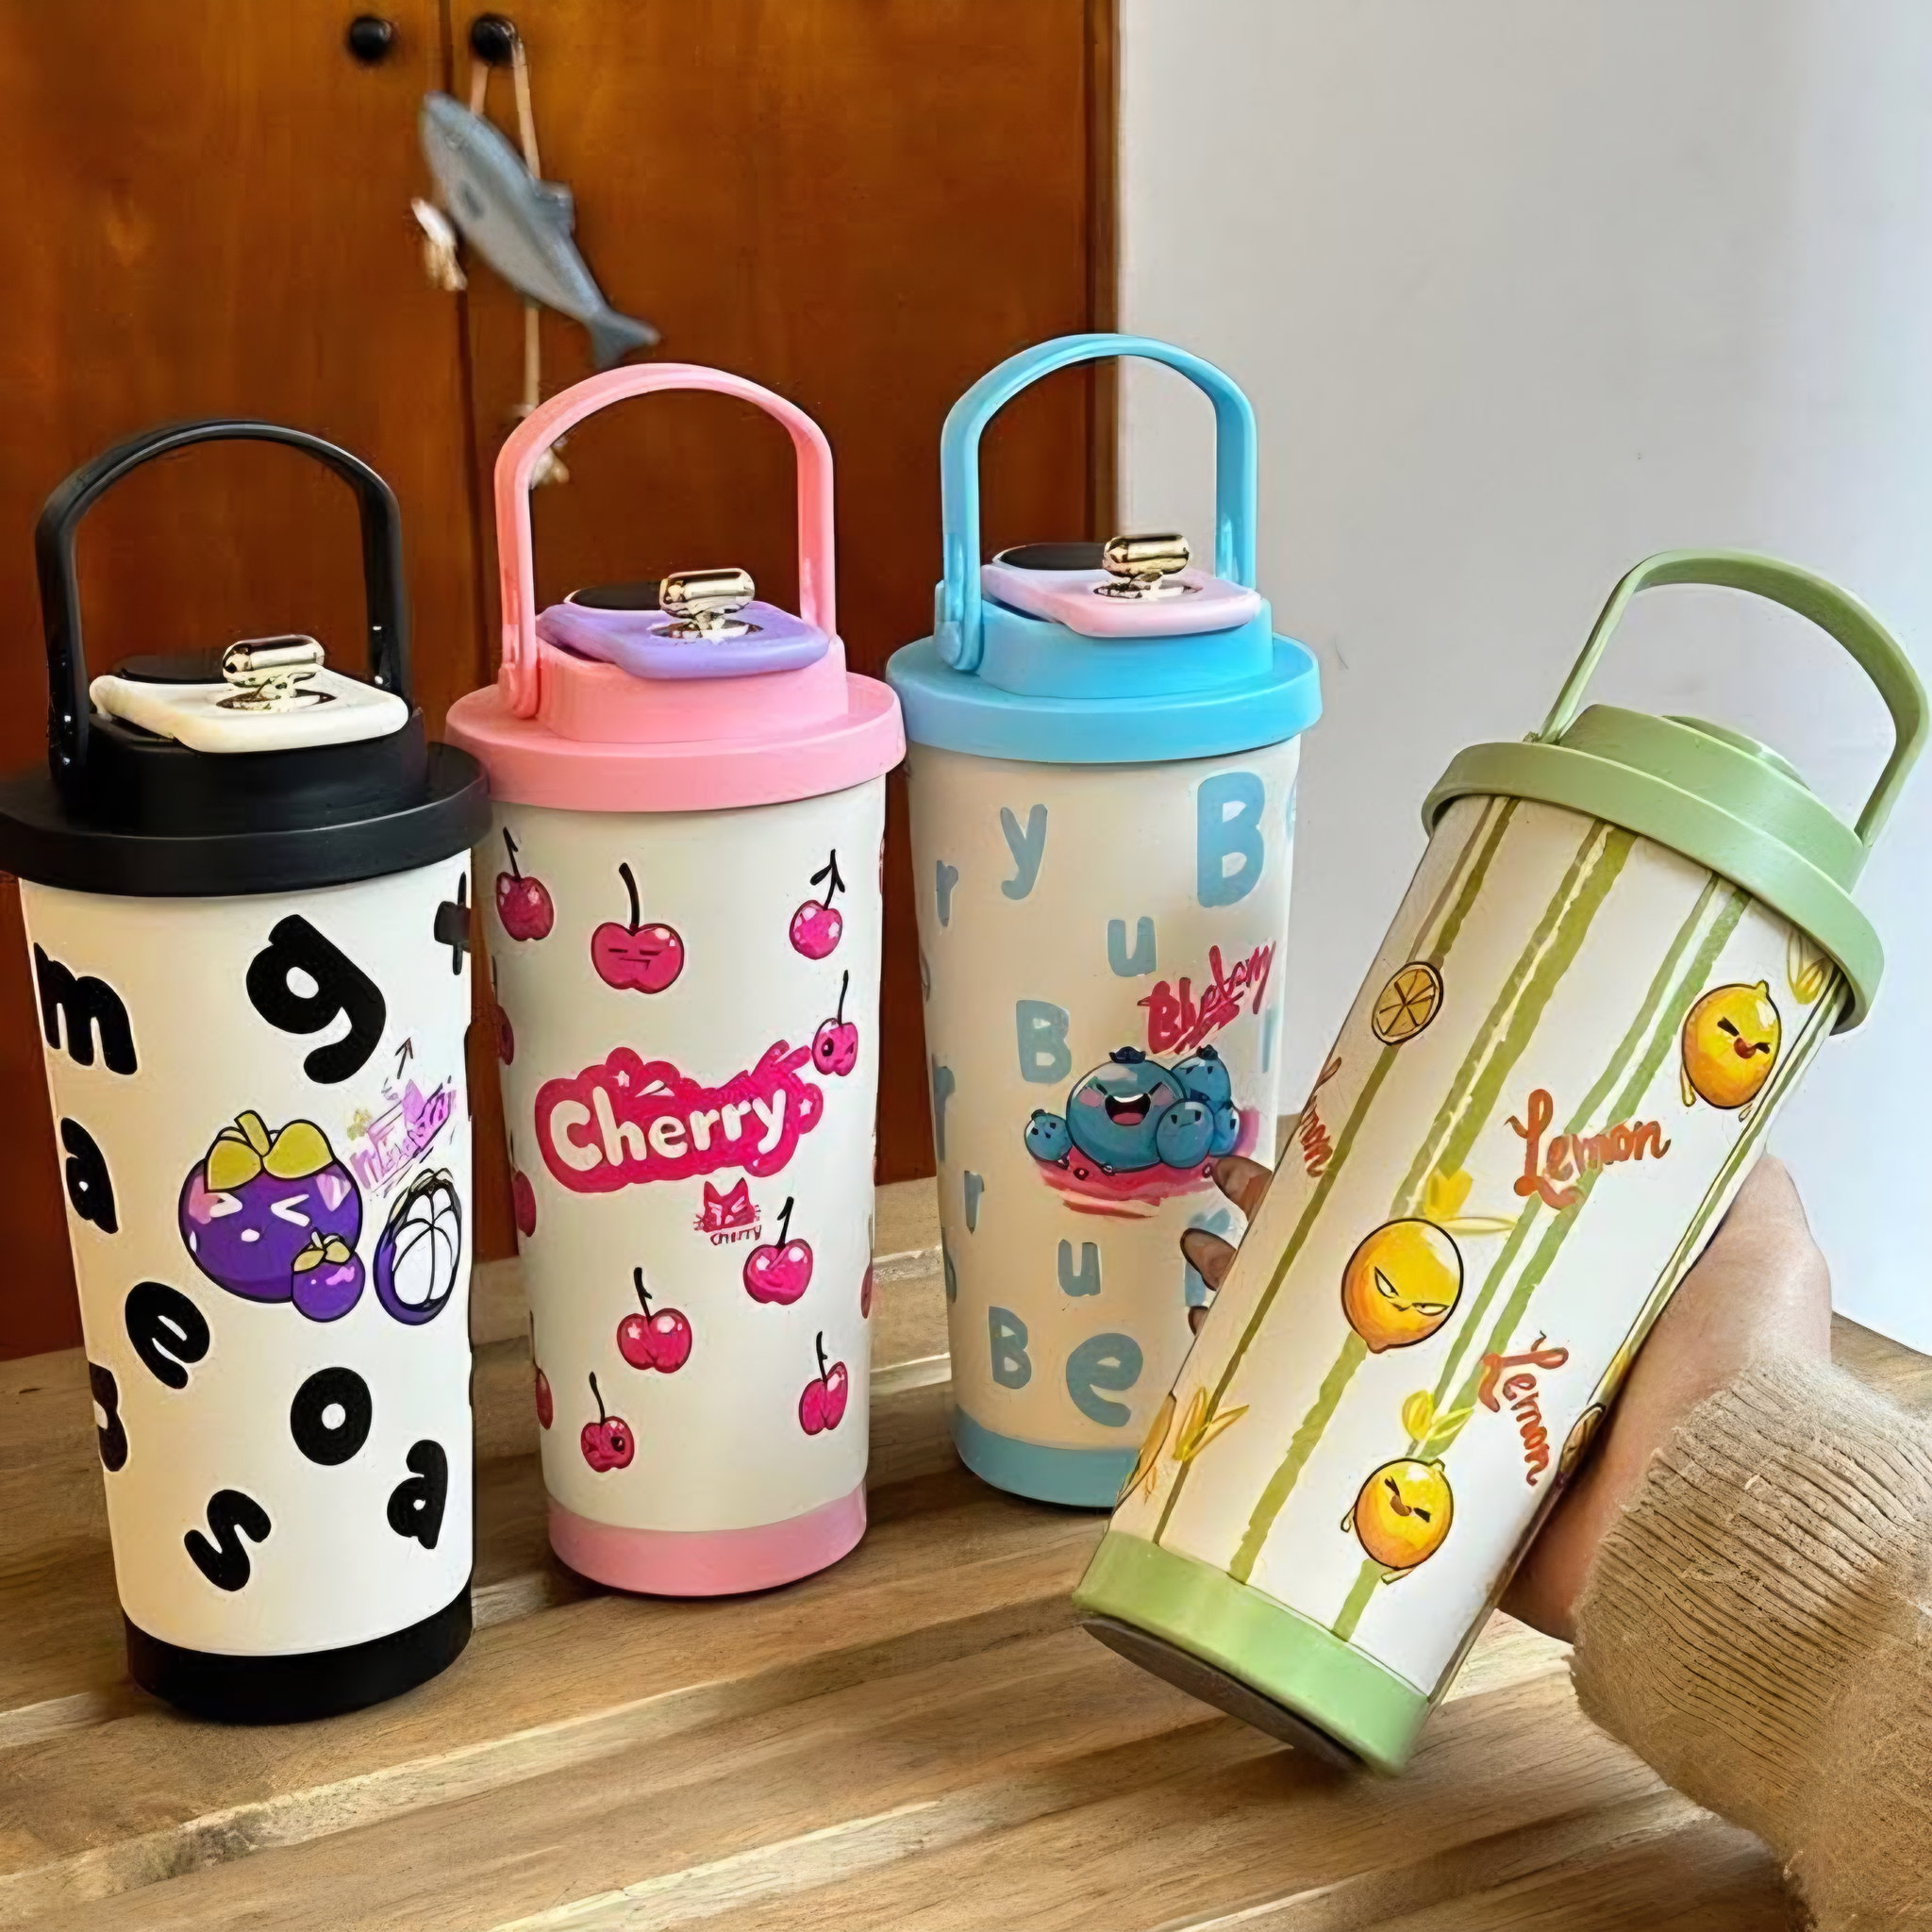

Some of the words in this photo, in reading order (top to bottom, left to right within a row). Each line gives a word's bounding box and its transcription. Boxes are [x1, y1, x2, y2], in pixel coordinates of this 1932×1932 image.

[1000, 804, 1048, 900] y
[1197, 772, 1265, 908] B
[33, 942, 138, 1074] m
[246, 914, 386, 1084] g
[1016, 1000, 1072, 1084] B
[550, 1086, 787, 1172] Cherry
[1505, 1089, 1671, 1208] Lemon
[989, 1306, 1032, 1390] B
[1066, 1333, 1143, 1427] e
[1478, 1330, 1569, 1486] Lemon
